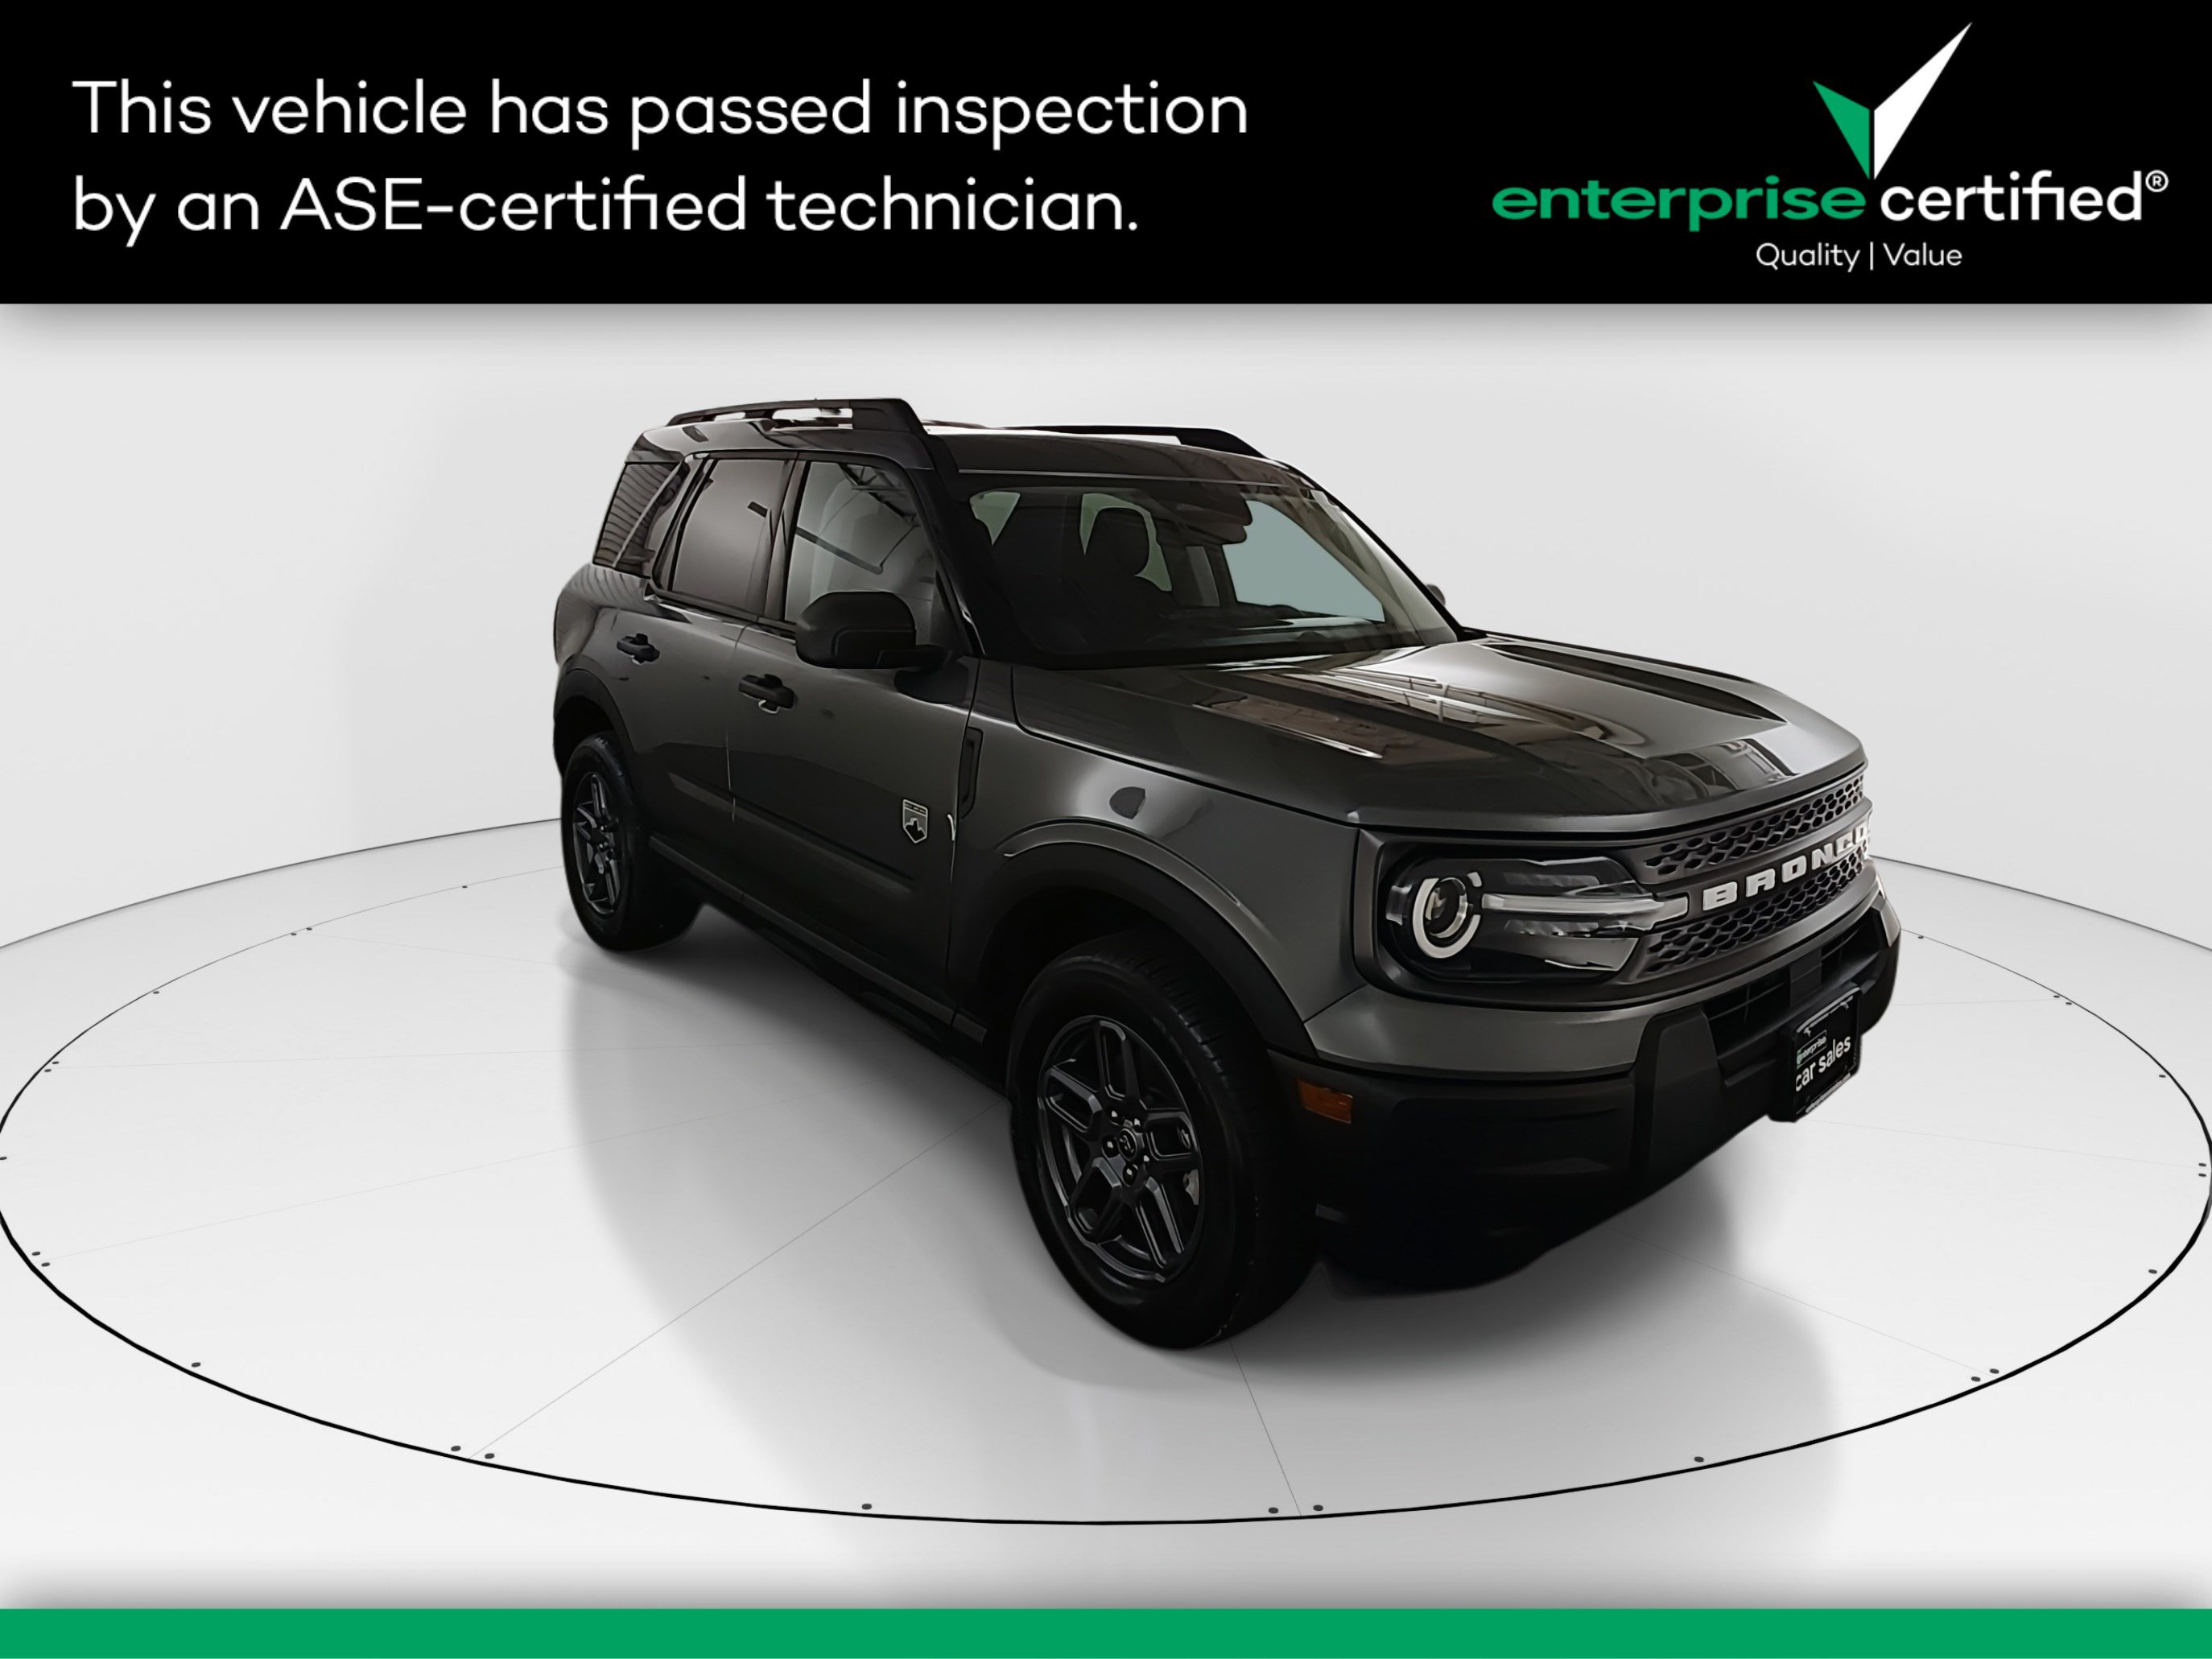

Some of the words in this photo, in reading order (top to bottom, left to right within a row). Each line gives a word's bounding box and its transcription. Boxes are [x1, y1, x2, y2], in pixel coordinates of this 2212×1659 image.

[1702, 820, 1868, 911] BRONCO
[1795, 1061, 1816, 1092] car
[1818, 1035, 1851, 1073] sales
